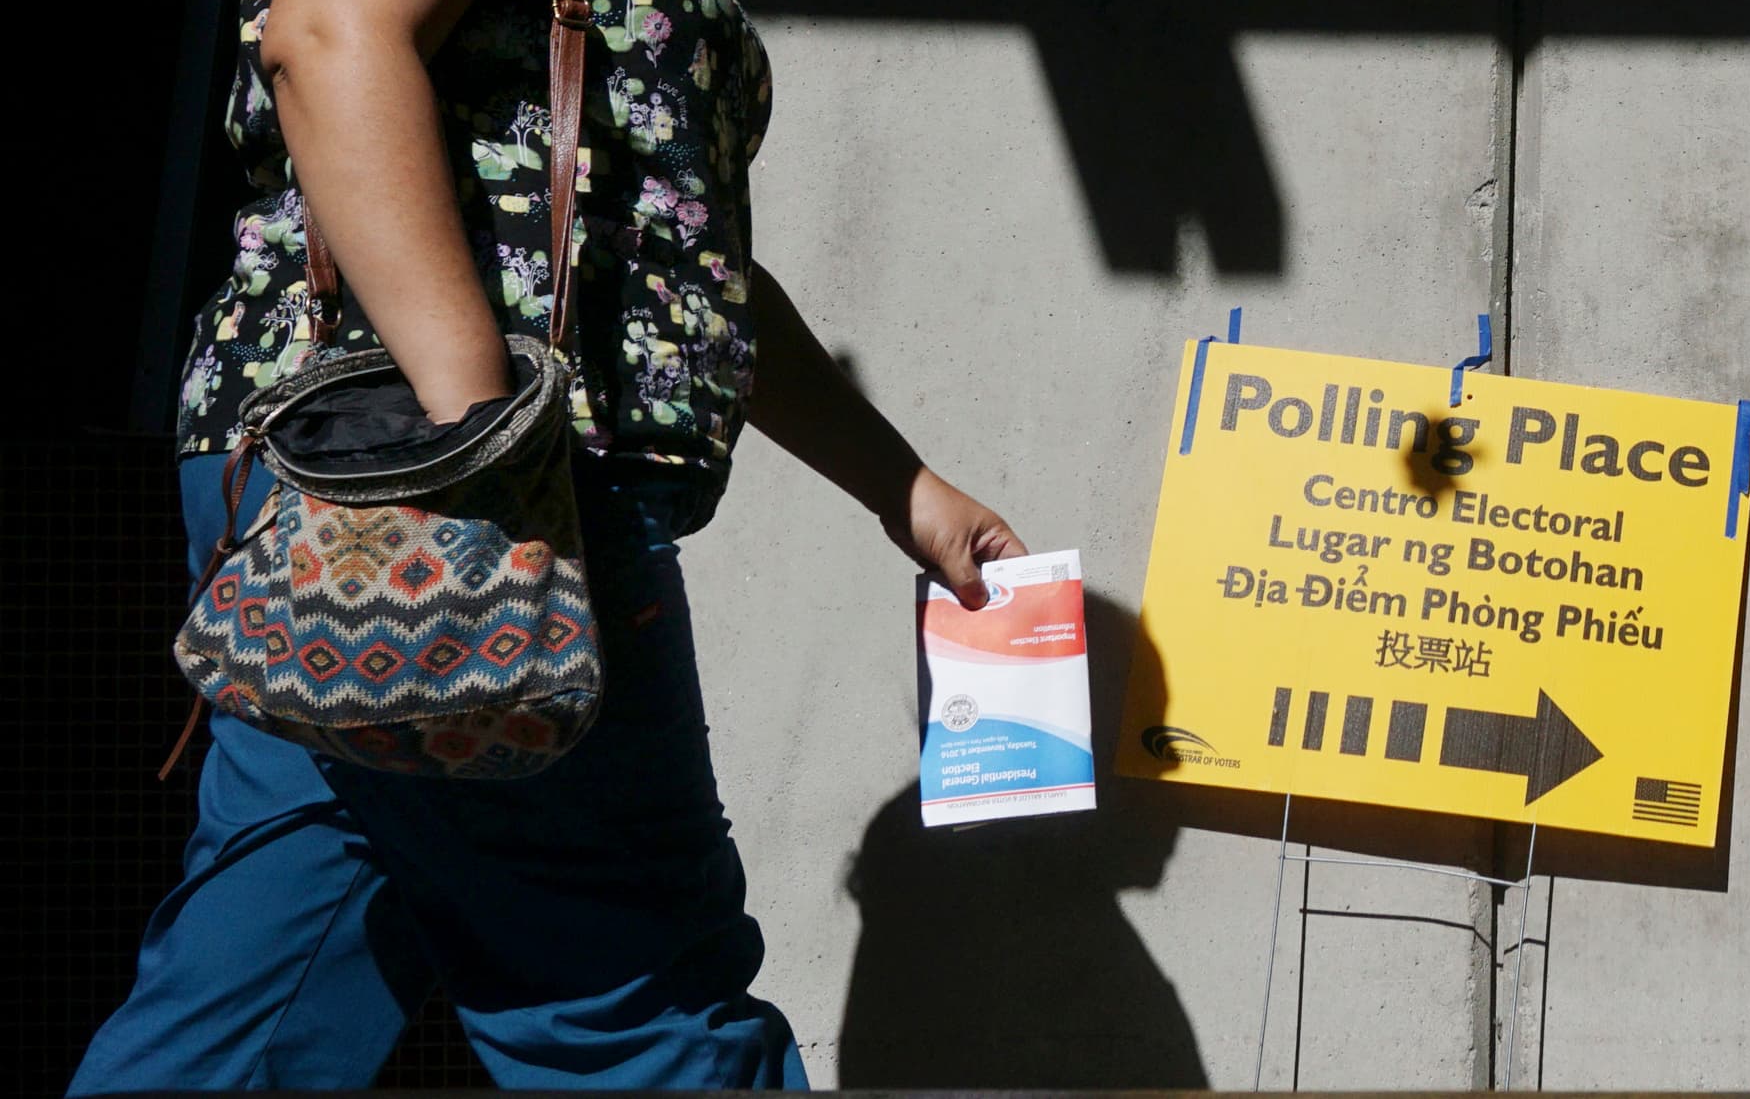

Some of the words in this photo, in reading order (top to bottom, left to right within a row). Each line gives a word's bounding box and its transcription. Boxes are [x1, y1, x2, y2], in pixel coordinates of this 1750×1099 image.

[1220, 373, 1480, 475] Polling
[1505, 406, 1711, 488] Place
[1303, 474, 1438, 519] Centro
[1451, 490, 1624, 543] Electoral
[1268, 516, 1390, 566] Lugar
[1403, 539, 1452, 576] ng
[1467, 538, 1643, 592] Botohan
[1216, 564, 1289, 610] Địa
[1295, 556, 1407, 617] Điểm
[1421, 586, 1544, 644] Phòng
[1556, 603, 1664, 650] Phiếu
[1033, 622, 1075, 631] Information
[1009, 636, 1038, 645] Election
[1375, 630, 1493, 678] 投票站
[967, 743, 1004, 754] November
[941, 762, 980, 774] Election
[1203, 757, 1213, 766] OF
[1214, 759, 1241, 769] VOTERS
[980, 767, 1036, 781] Presidential
[942, 774, 979, 789] General
